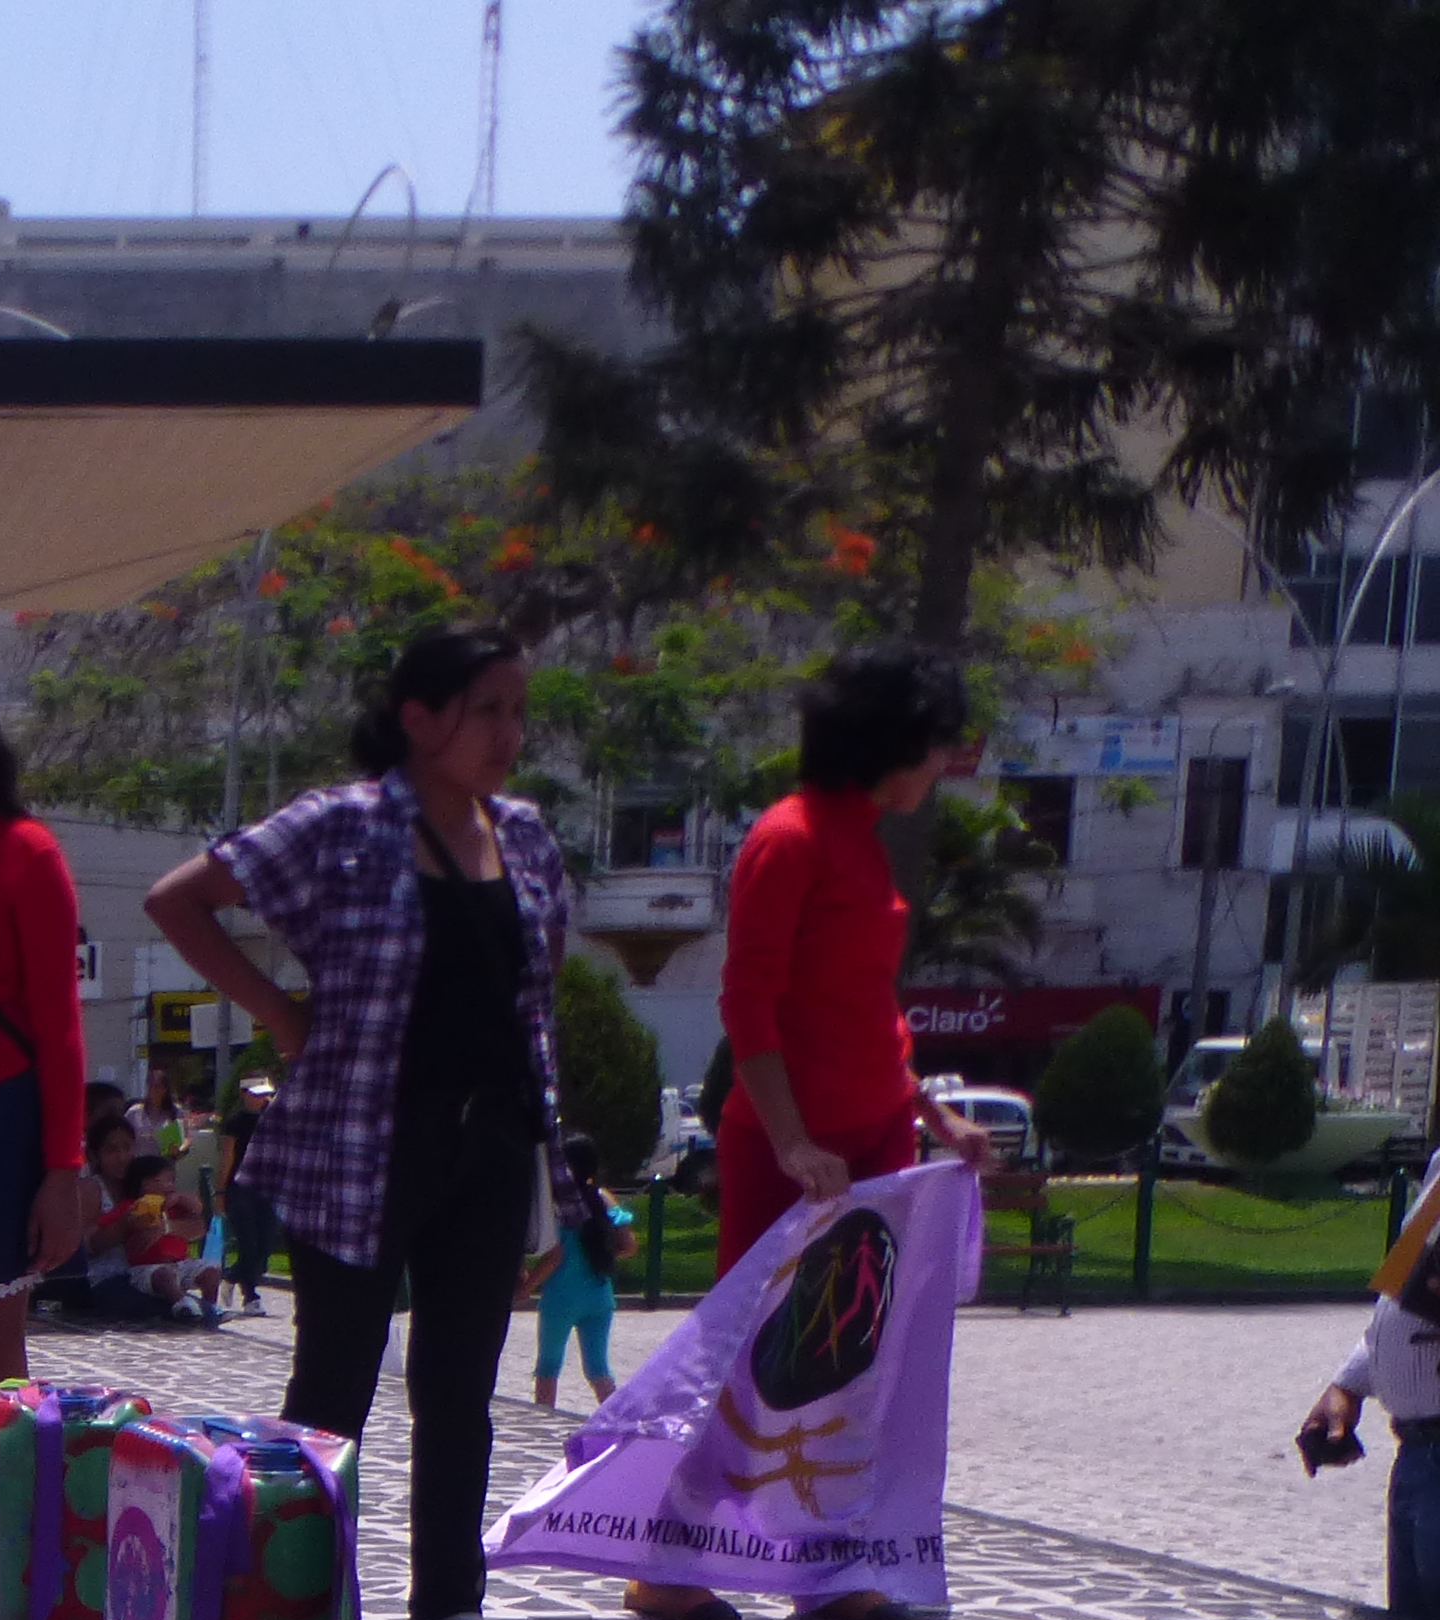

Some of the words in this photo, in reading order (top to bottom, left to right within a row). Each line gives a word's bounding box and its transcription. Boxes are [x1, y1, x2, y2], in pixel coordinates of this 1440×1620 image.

[905, 1005, 988, 1033] Claro
[544, 1510, 636, 1541] MARCHA
[640, 1517, 743, 1556] MUNDIAL
[745, 1534, 775, 1561] DE
[780, 1539, 824, 1563] LAS
